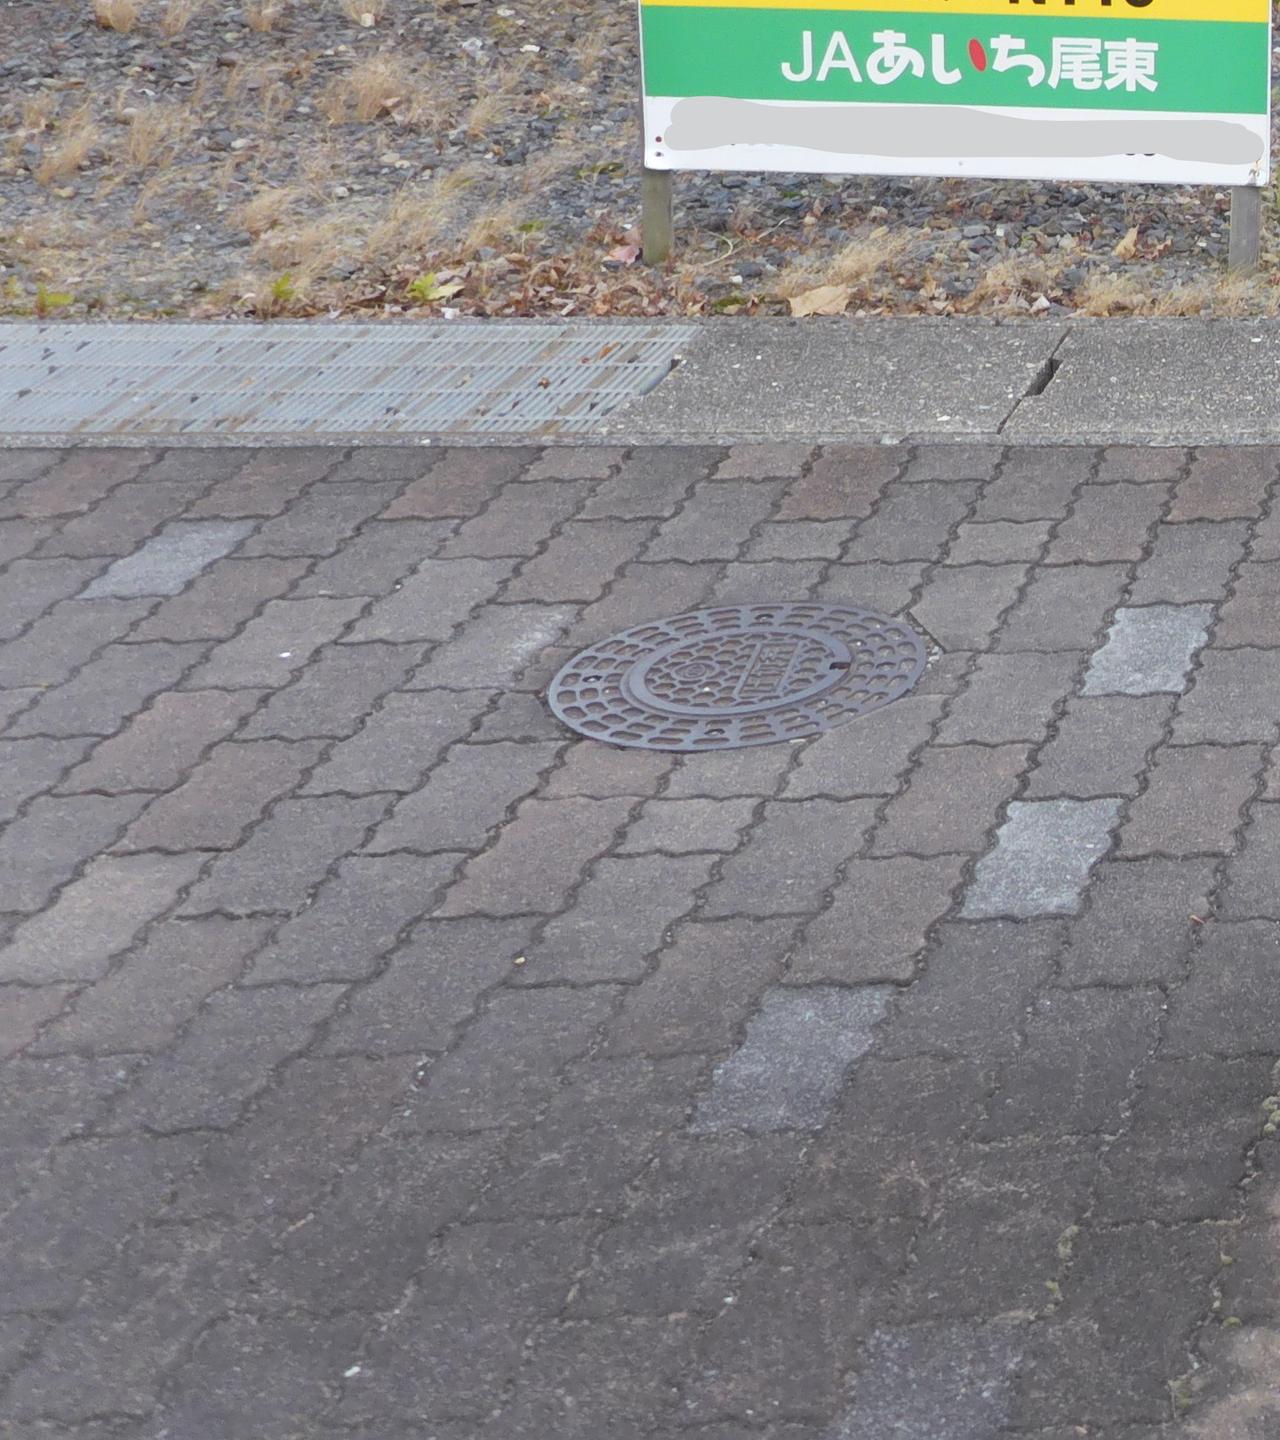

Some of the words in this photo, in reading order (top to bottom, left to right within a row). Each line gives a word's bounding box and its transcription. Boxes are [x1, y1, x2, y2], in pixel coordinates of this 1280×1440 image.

[781, 29, 1159, 93] JAあいち尾東
